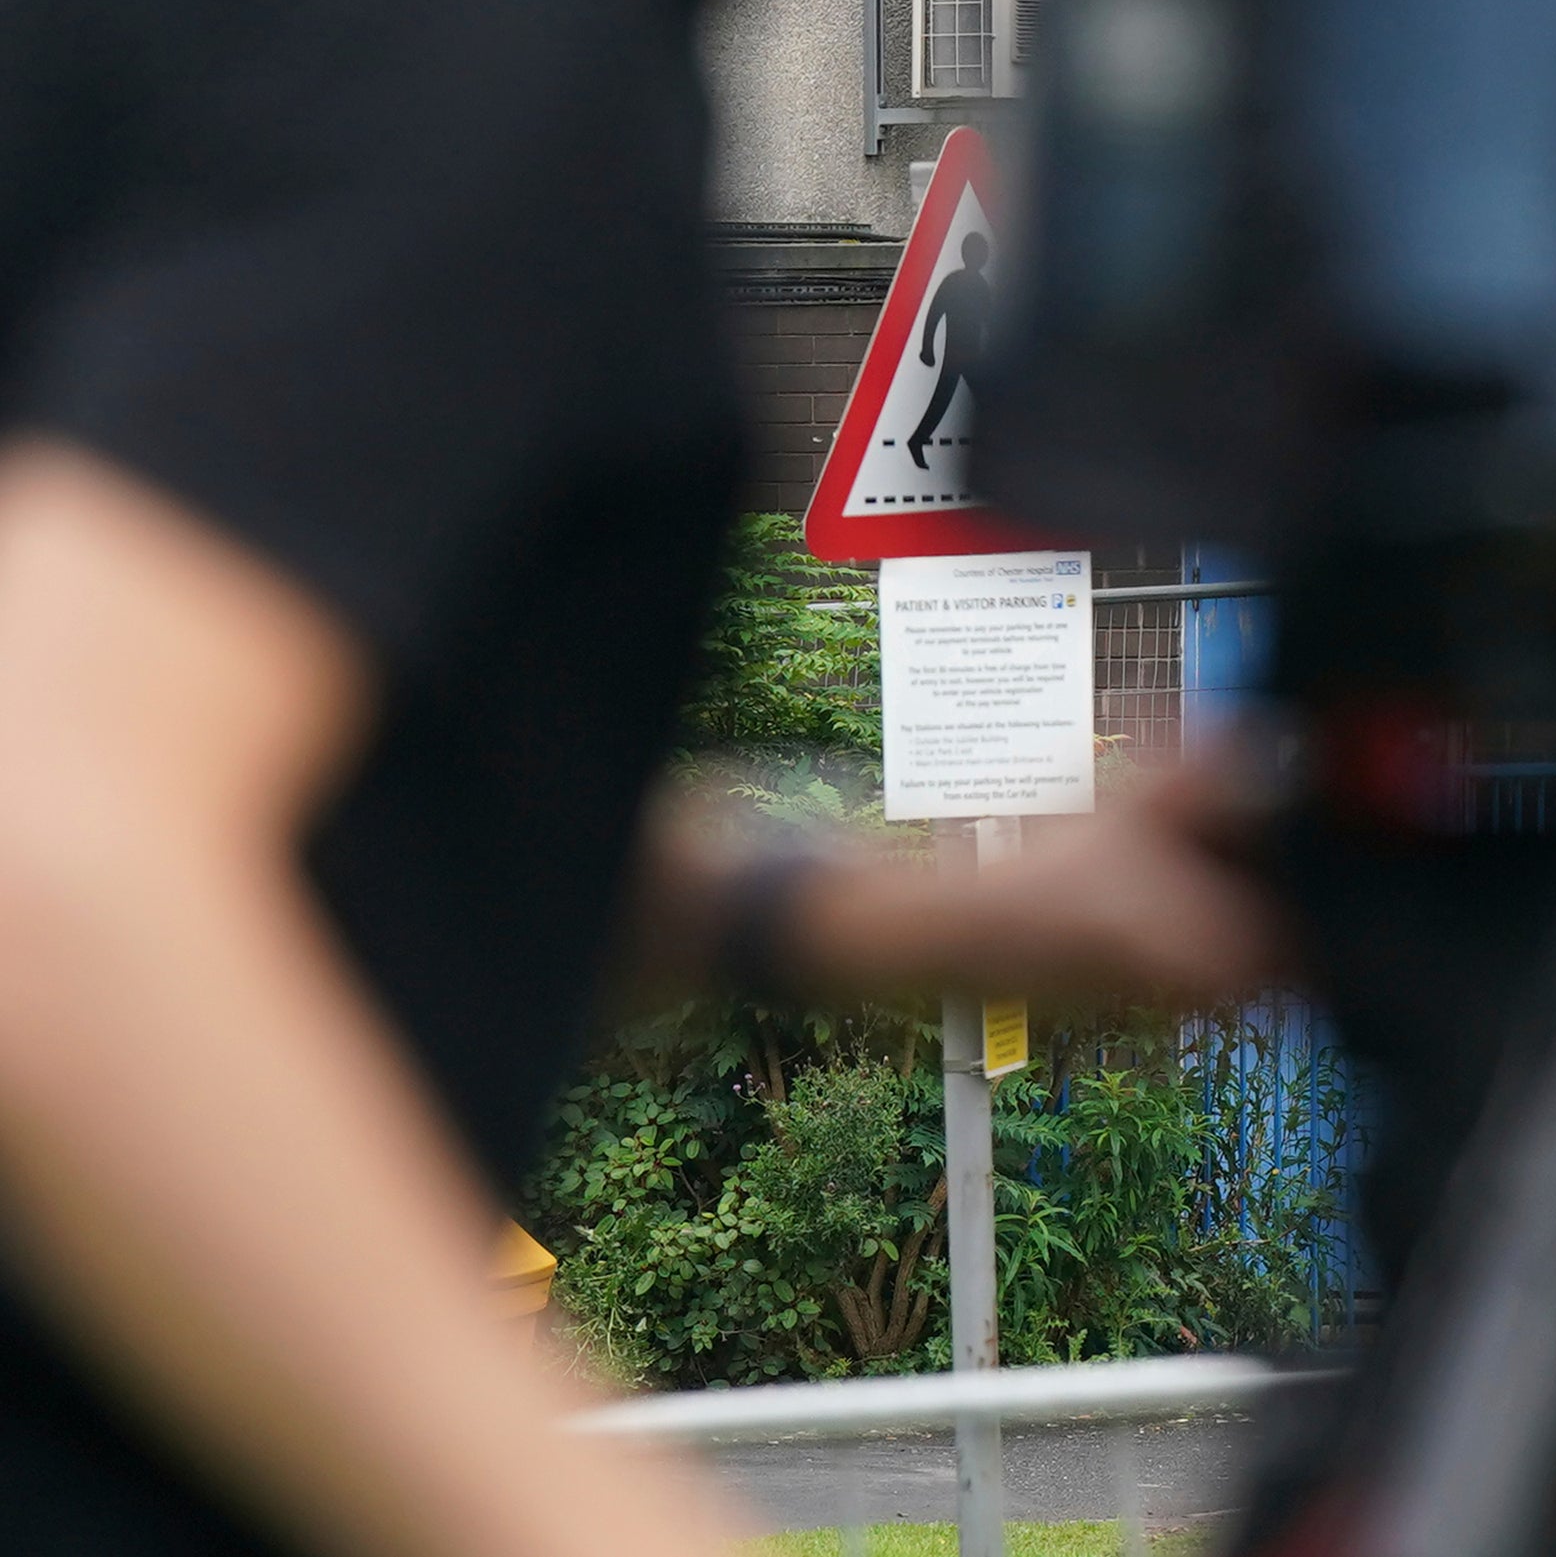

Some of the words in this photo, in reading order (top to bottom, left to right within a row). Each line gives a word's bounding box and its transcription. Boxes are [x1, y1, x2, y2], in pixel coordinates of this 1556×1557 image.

[1056, 561, 1081, 575] NHS
[895, 600, 938, 612] PATIENT
[954, 598, 996, 610] VISITOR
[1000, 596, 1047, 609] PARKING
